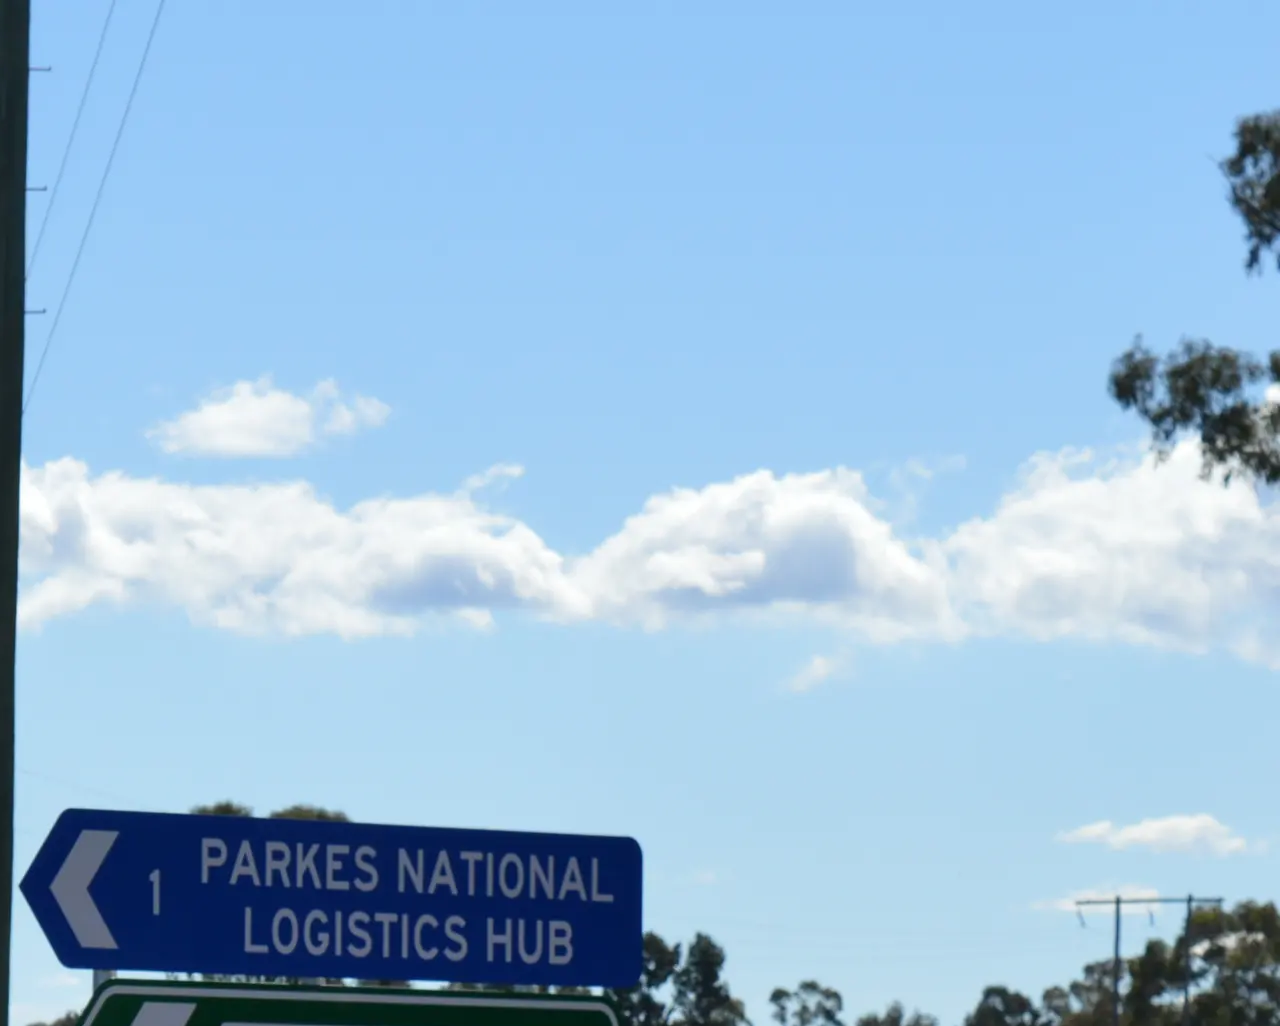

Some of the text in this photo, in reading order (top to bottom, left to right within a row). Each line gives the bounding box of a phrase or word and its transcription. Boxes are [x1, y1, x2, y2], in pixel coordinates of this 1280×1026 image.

[149, 869, 161, 916] 1
[201, 837, 614, 902] PARKES NATIONAL
[244, 906, 573, 965] LOGISTICS HUB
